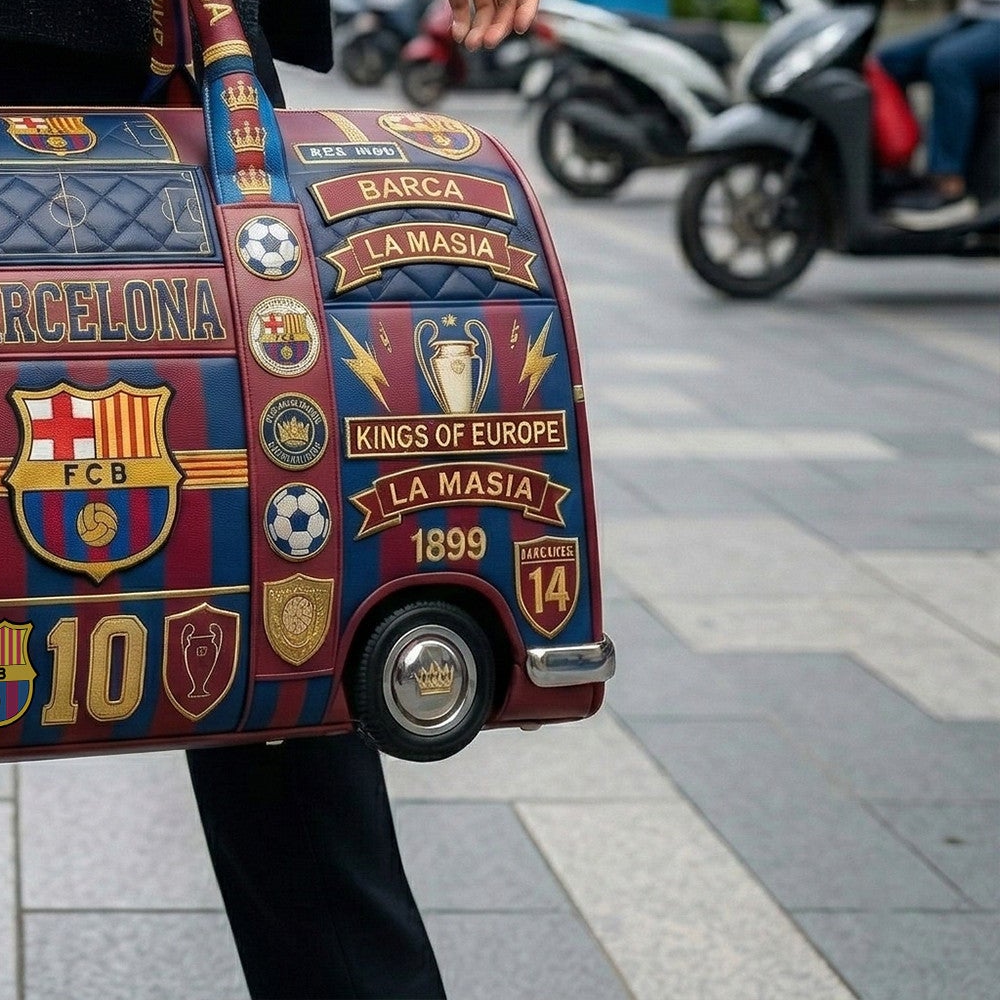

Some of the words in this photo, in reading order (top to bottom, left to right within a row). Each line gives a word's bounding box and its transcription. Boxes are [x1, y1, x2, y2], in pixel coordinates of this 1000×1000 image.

[357, 176, 464, 201] BARCA
[364, 233, 404, 260] LA
[408, 230, 495, 256] MASIA
[355, 421, 429, 450] KINGS
[435, 421, 465, 448] OF
[471, 420, 561, 447] EUROPE
[63, 463, 127, 487] FCB
[389, 474, 429, 506] LA
[438, 470, 533, 502] MASIA
[411, 526, 488, 564] 1899
[528, 565, 571, 614] 14
[40, 614, 148, 727] 10
